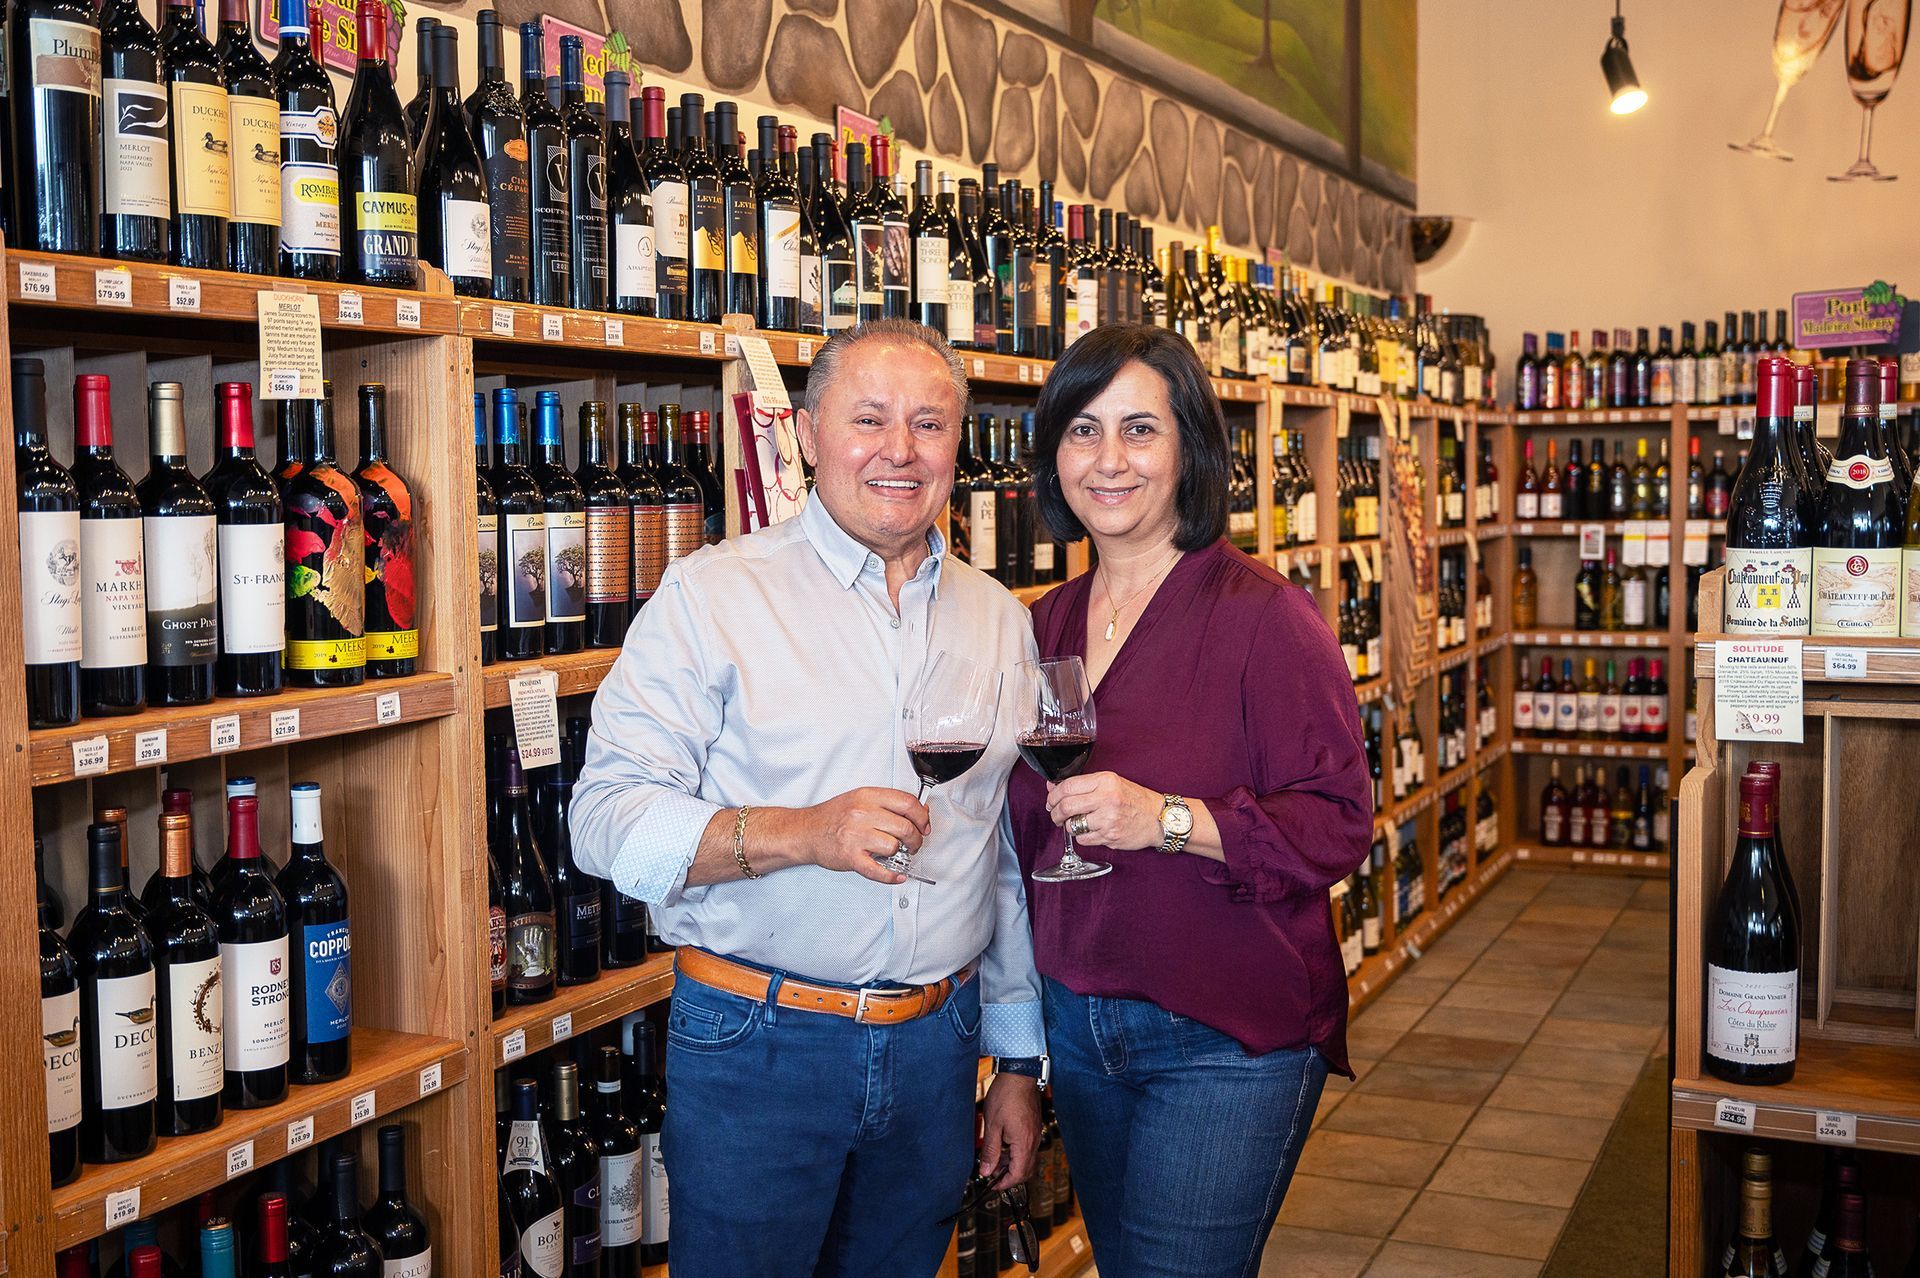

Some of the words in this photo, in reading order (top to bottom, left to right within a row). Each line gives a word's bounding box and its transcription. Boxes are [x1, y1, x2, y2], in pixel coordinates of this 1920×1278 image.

[119, 143, 151, 154] MERLOT
[363, 233, 409, 256] GRAND
[24, 283, 50, 294] $76.99
[98, 290, 126, 300] $79.99
[176, 297, 196, 307] $52.99
[278, 302, 301, 311] MERLOT
[1825, 297, 1870, 319] Port
[340, 311, 362, 320] $64.99
[398, 313, 419, 323] $54.99
[1801, 319, 1850, 337] Madeira
[1852, 316, 1896, 335] Sherry
[274, 381, 294, 392] $54.99
[1852, 468, 1867, 476] 2018
[162, 617, 198, 631] GHOST
[1757, 615, 1768, 628] de
[1769, 615, 1778, 628] la
[1733, 645, 1785, 653] SOLITUDE
[1832, 662, 1857, 671] $64.99
[275, 726, 296, 736] $21.99
[217, 734, 235, 745] $21.99
[141, 748, 161, 759] $29.99
[521, 747, 541, 760] $24.99
[79, 756, 104, 767] $36.99
[1719, 988, 1743, 999] DOMAINE
[264, 1017, 286, 1029] MERLOT
[1728, 1017, 1745, 1027] Côtes
[1746, 1018, 1755, 1028] du
[1756, 1018, 1777, 1029] Rhône
[1725, 1043, 1749, 1054] ALAIN
[1750, 1046, 1778, 1056] JAUME
[355, 1108, 370, 1121] $15.99
[1724, 1105, 1745, 1113] VENEUR
[1720, 1112, 1747, 1126] $24.99
[1820, 1128, 1848, 1137] $24.99
[290, 1132, 311, 1145] $18.99
[516, 1136, 530, 1149] 91
[230, 1159, 248, 1173] $15.99
[113, 1206, 136, 1220] $19.99
